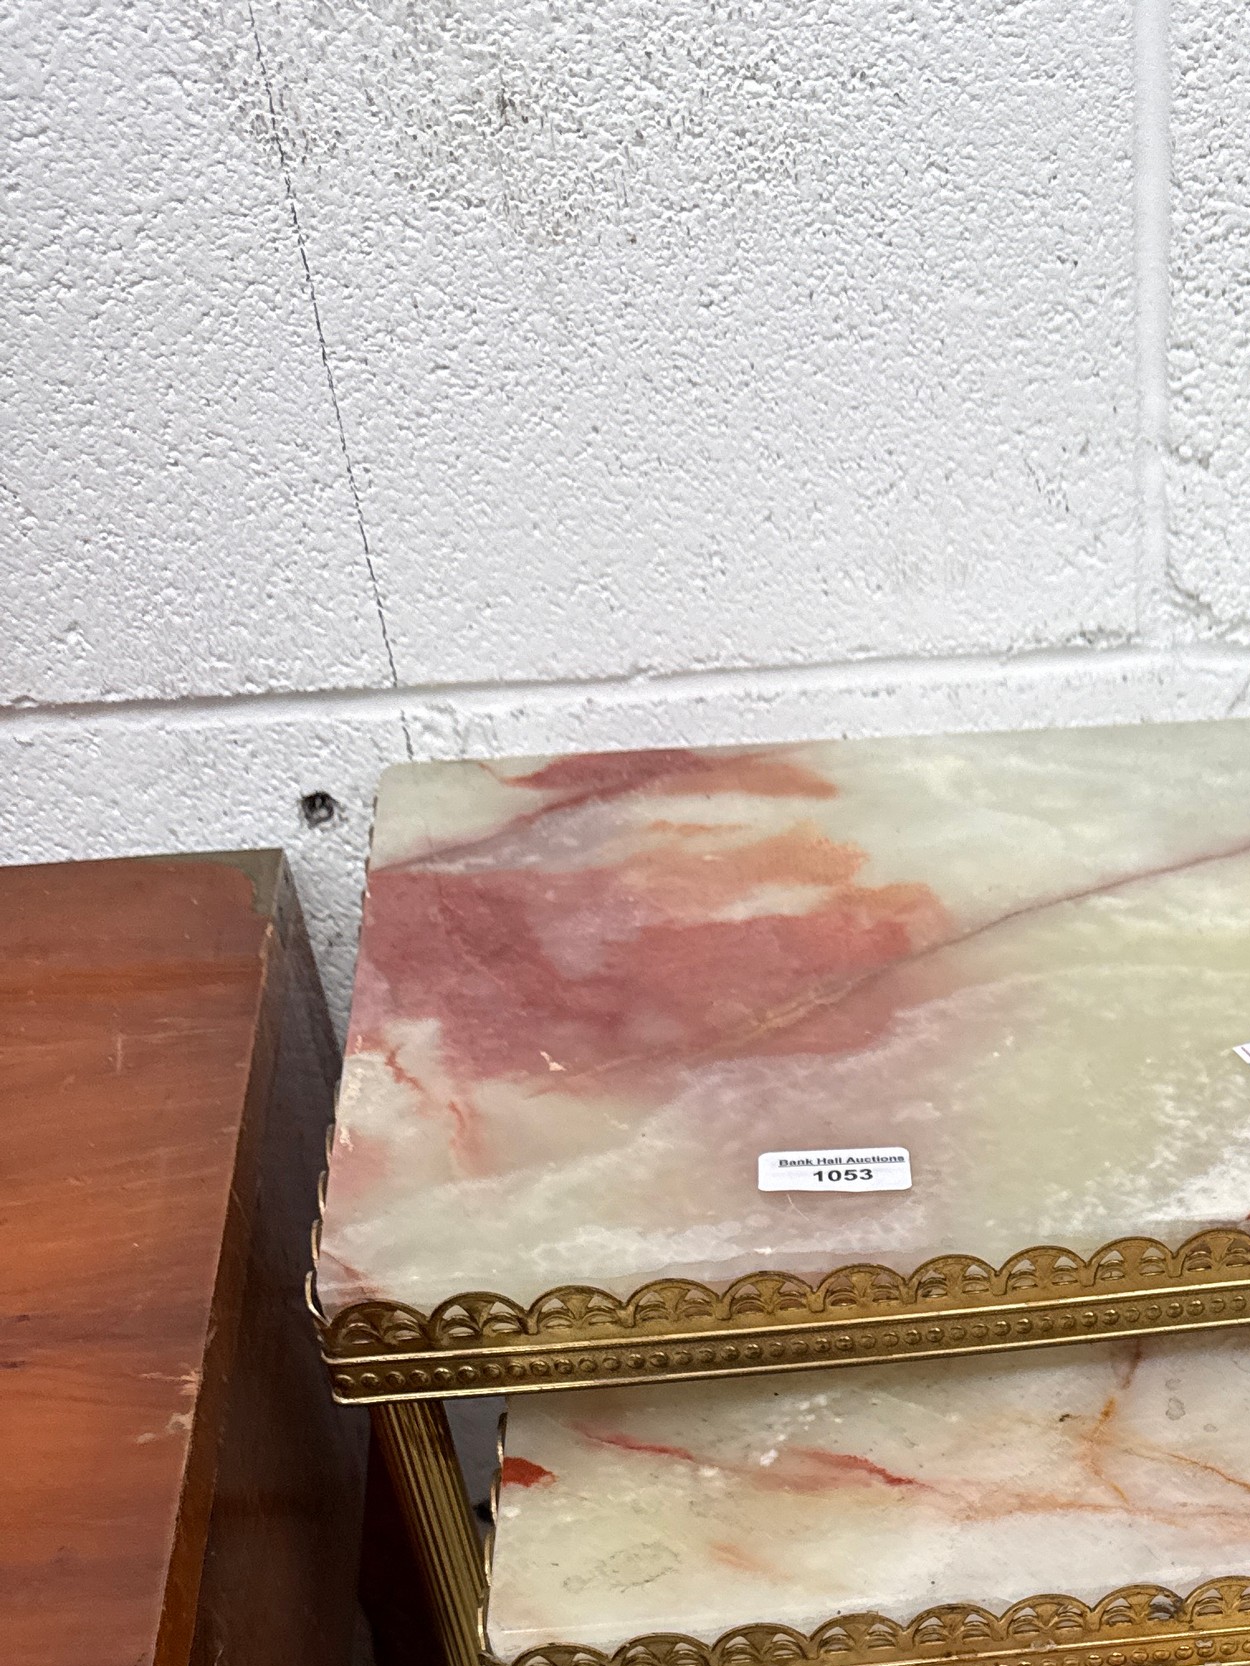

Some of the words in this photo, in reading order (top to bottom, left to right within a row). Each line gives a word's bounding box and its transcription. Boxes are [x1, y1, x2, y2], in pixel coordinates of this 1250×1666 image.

[778, 1158, 813, 1167] Bank
[817, 1156, 842, 1165] Hall
[846, 1154, 906, 1164] Auctions
[813, 1168, 874, 1182] 1053
